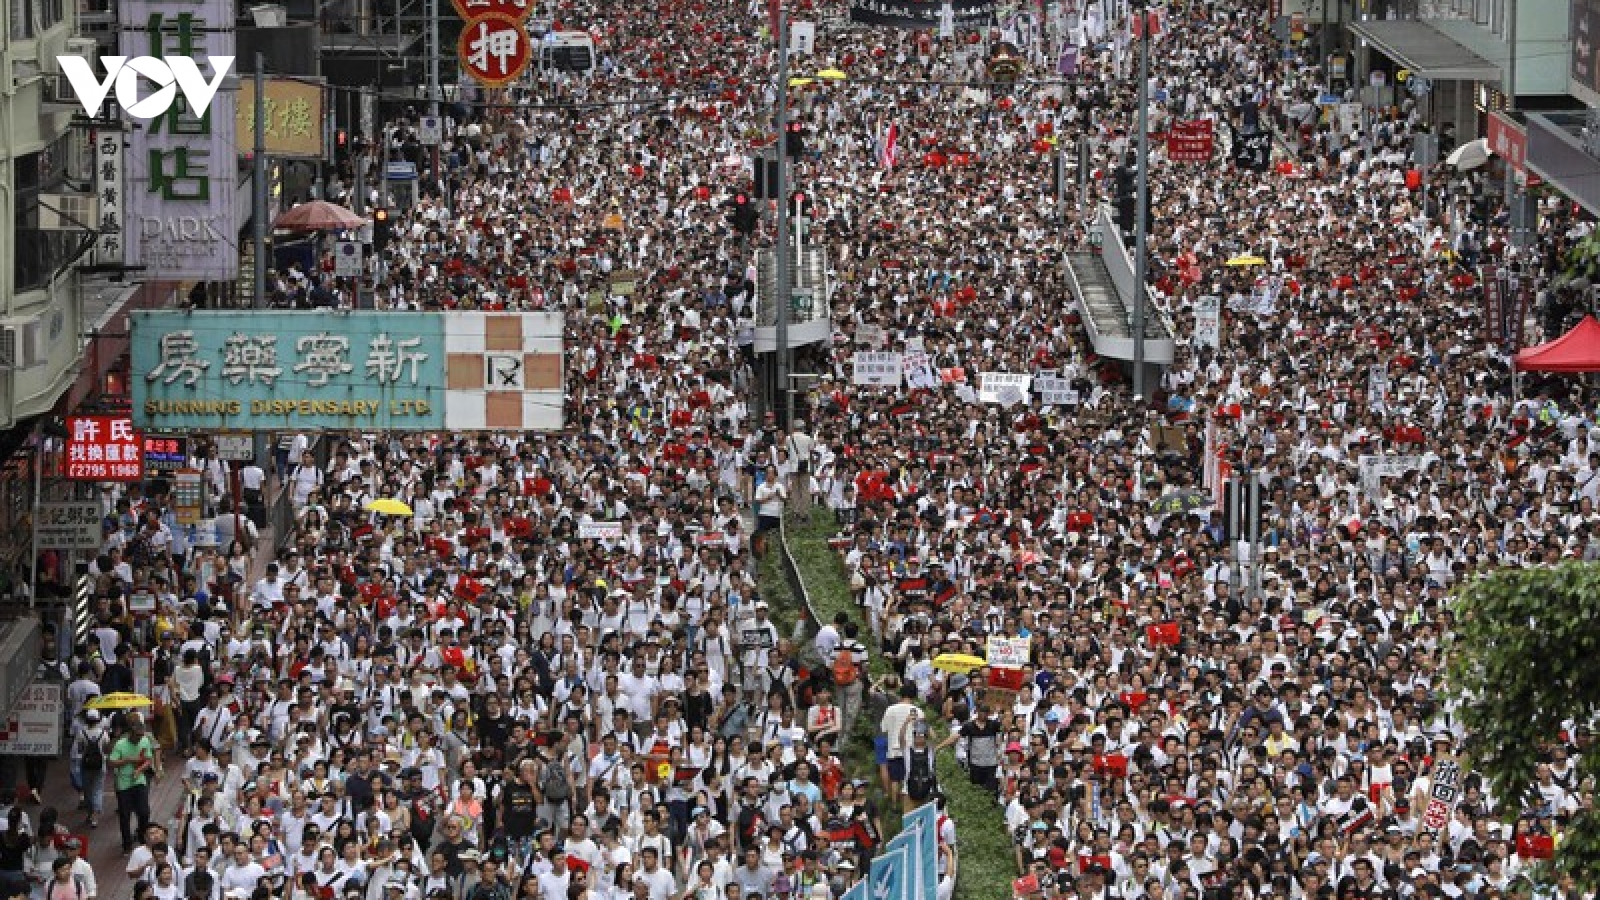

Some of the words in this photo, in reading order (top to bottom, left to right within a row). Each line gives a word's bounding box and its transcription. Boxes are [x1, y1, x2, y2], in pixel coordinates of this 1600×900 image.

[467, 21, 519, 75] 押
[140, 215, 219, 242] PARK
[145, 399, 241, 416] SUNNING
[250, 399, 380, 416] DISPENSARY
[74, 418, 134, 442] 許氏
